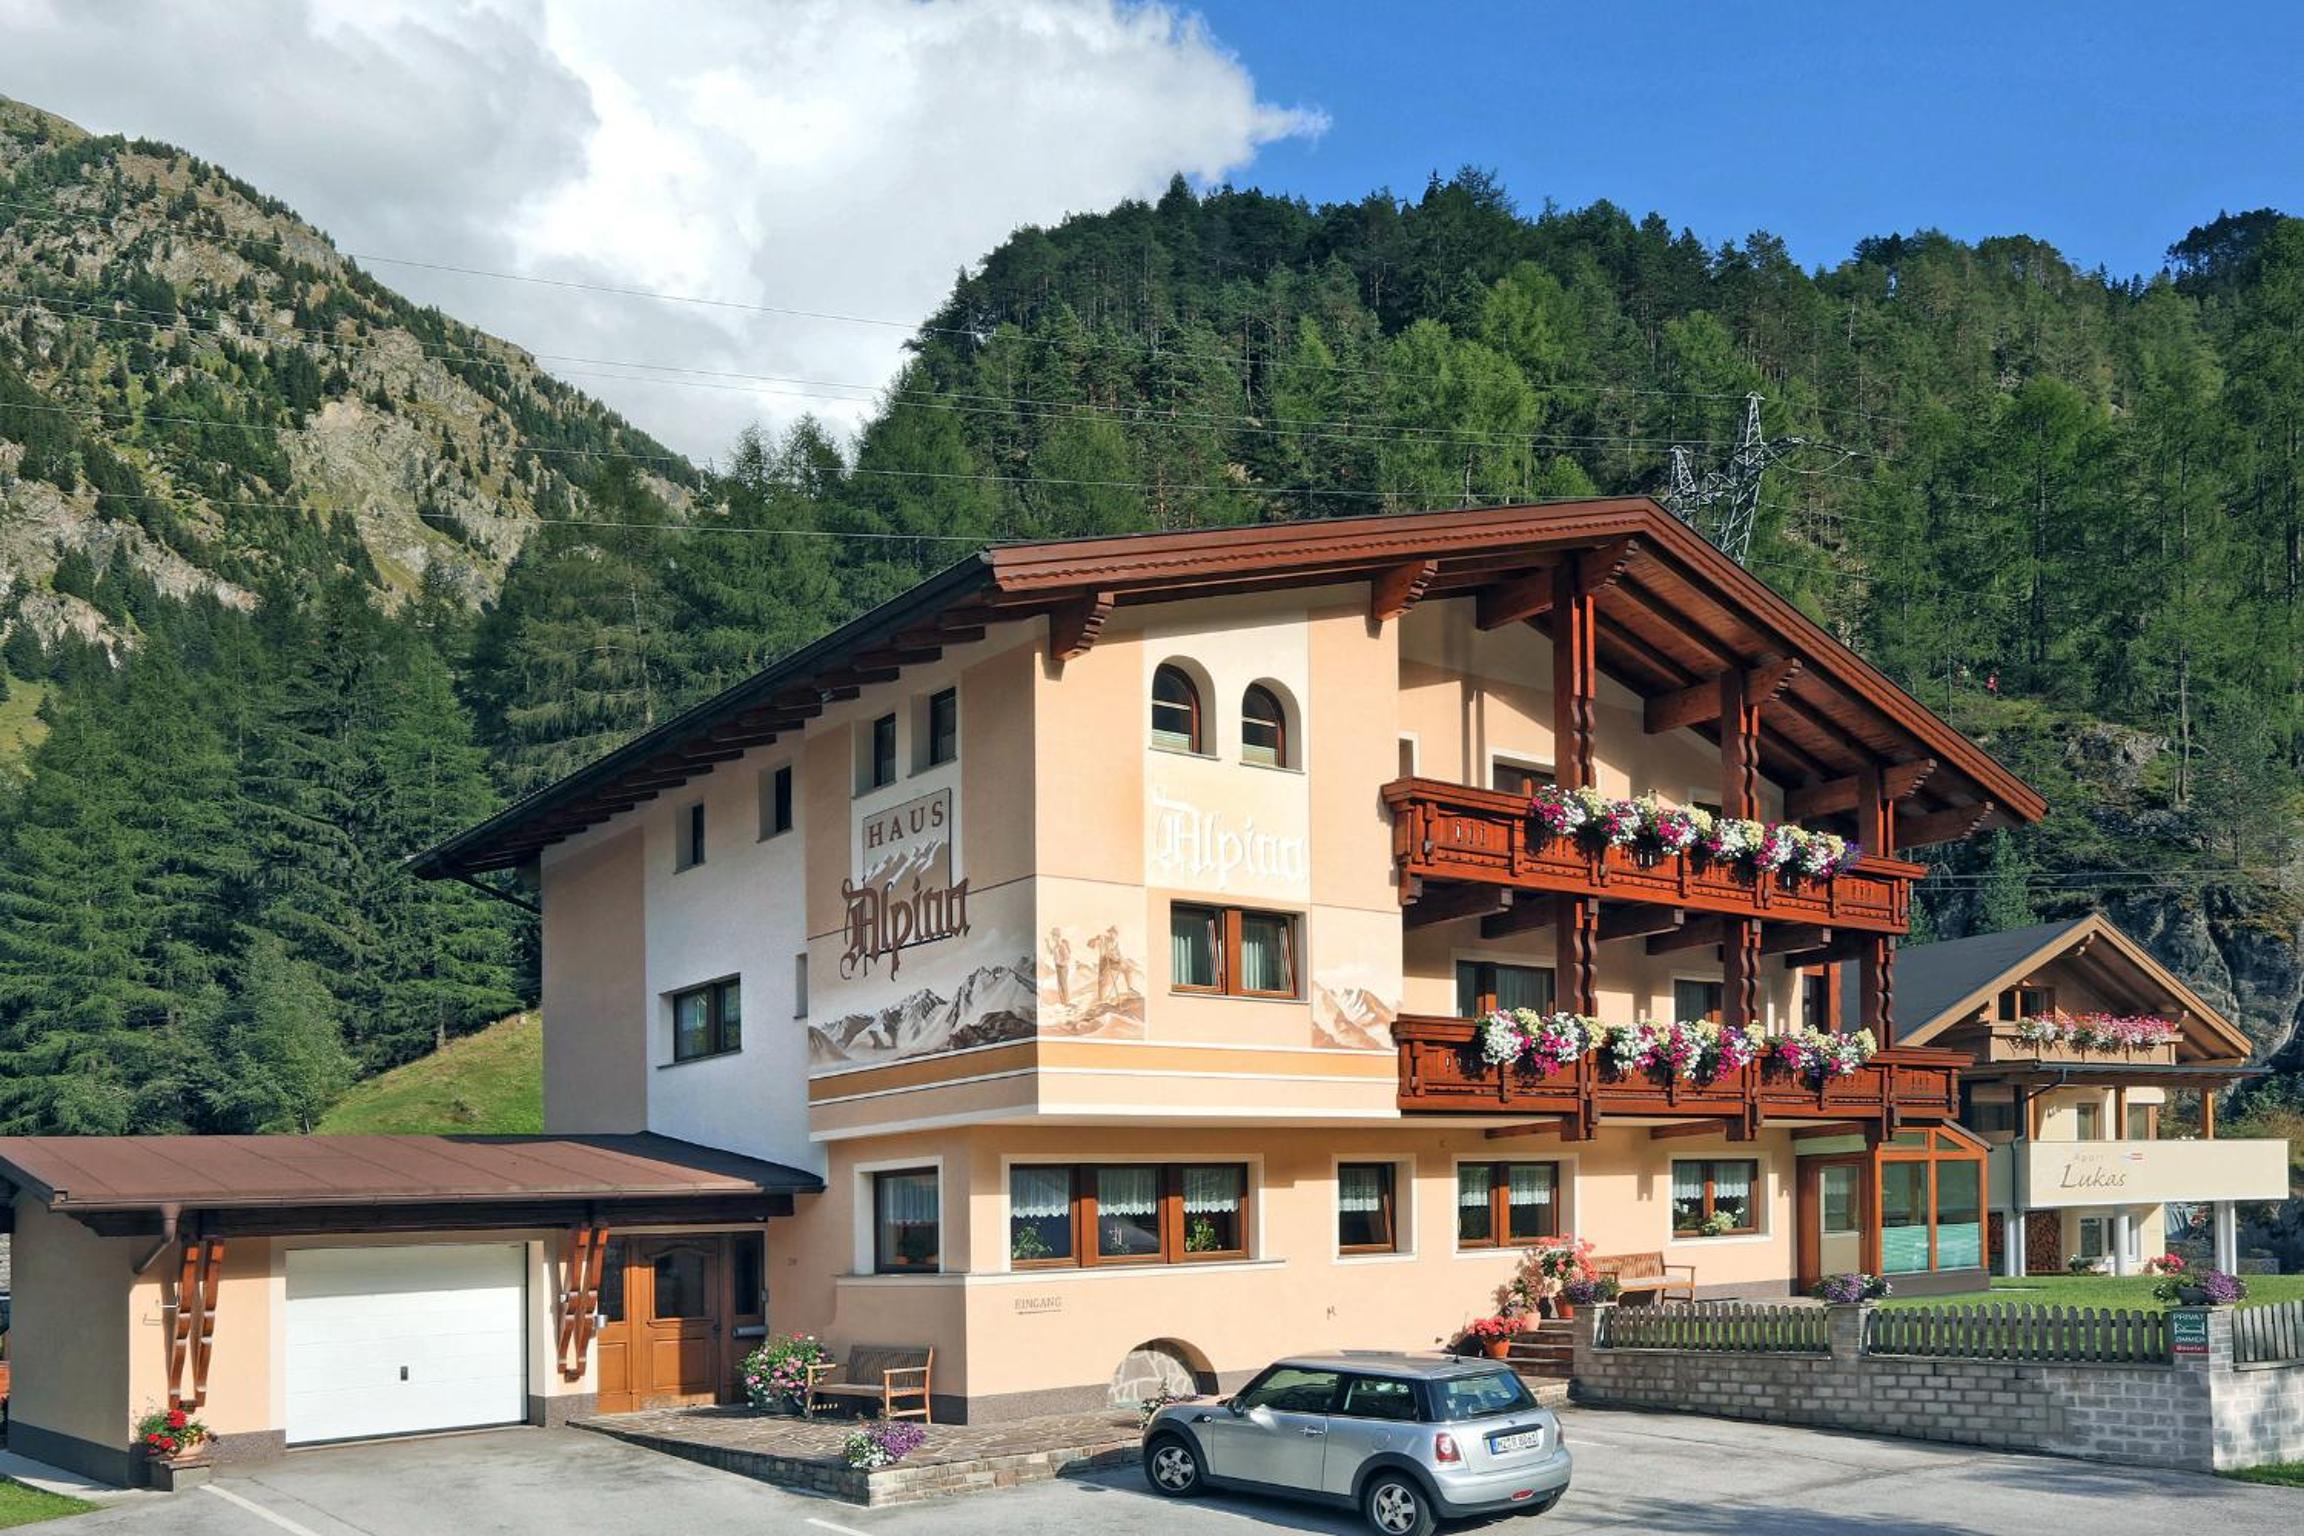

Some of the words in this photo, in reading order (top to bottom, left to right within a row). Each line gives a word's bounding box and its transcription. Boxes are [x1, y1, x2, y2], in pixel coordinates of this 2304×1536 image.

[868, 801, 945, 849] HAUS
[840, 875, 970, 982] Alpina
[2060, 1164, 2127, 1188] Lukas
[1014, 1296, 1063, 1310] EINGANG
[2173, 1313, 2205, 1321] PRIVAT
